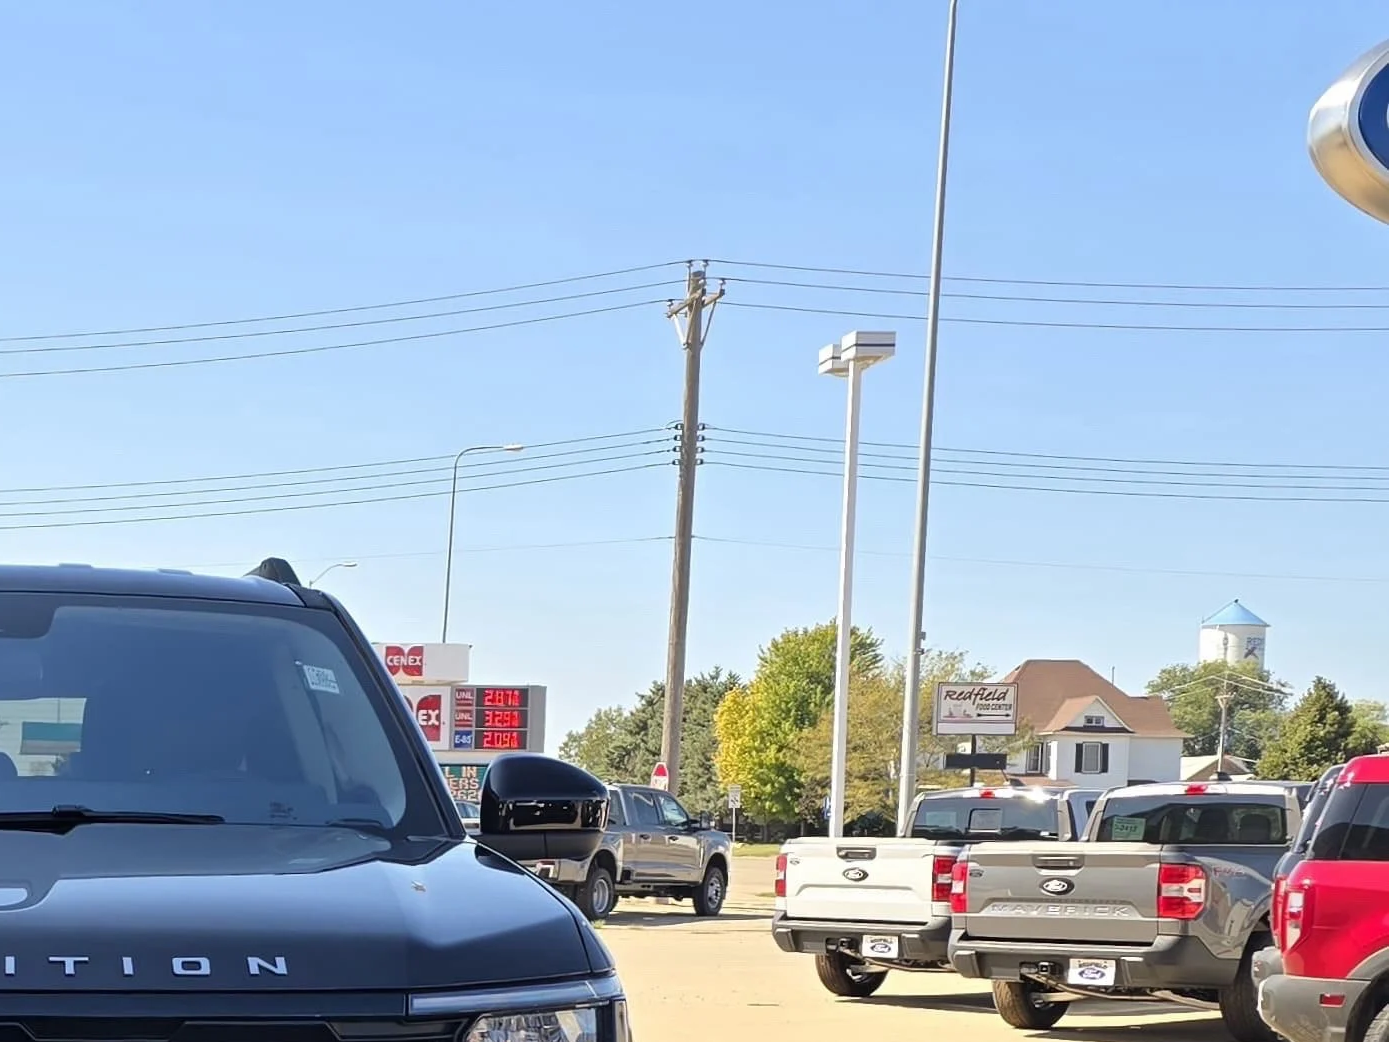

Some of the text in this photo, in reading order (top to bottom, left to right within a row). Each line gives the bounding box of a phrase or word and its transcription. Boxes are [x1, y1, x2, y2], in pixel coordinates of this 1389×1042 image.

[386, 655, 422, 666] CENEX
[944, 687, 1009, 706] Redfield
[991, 903, 1130, 917] MAVERICK
